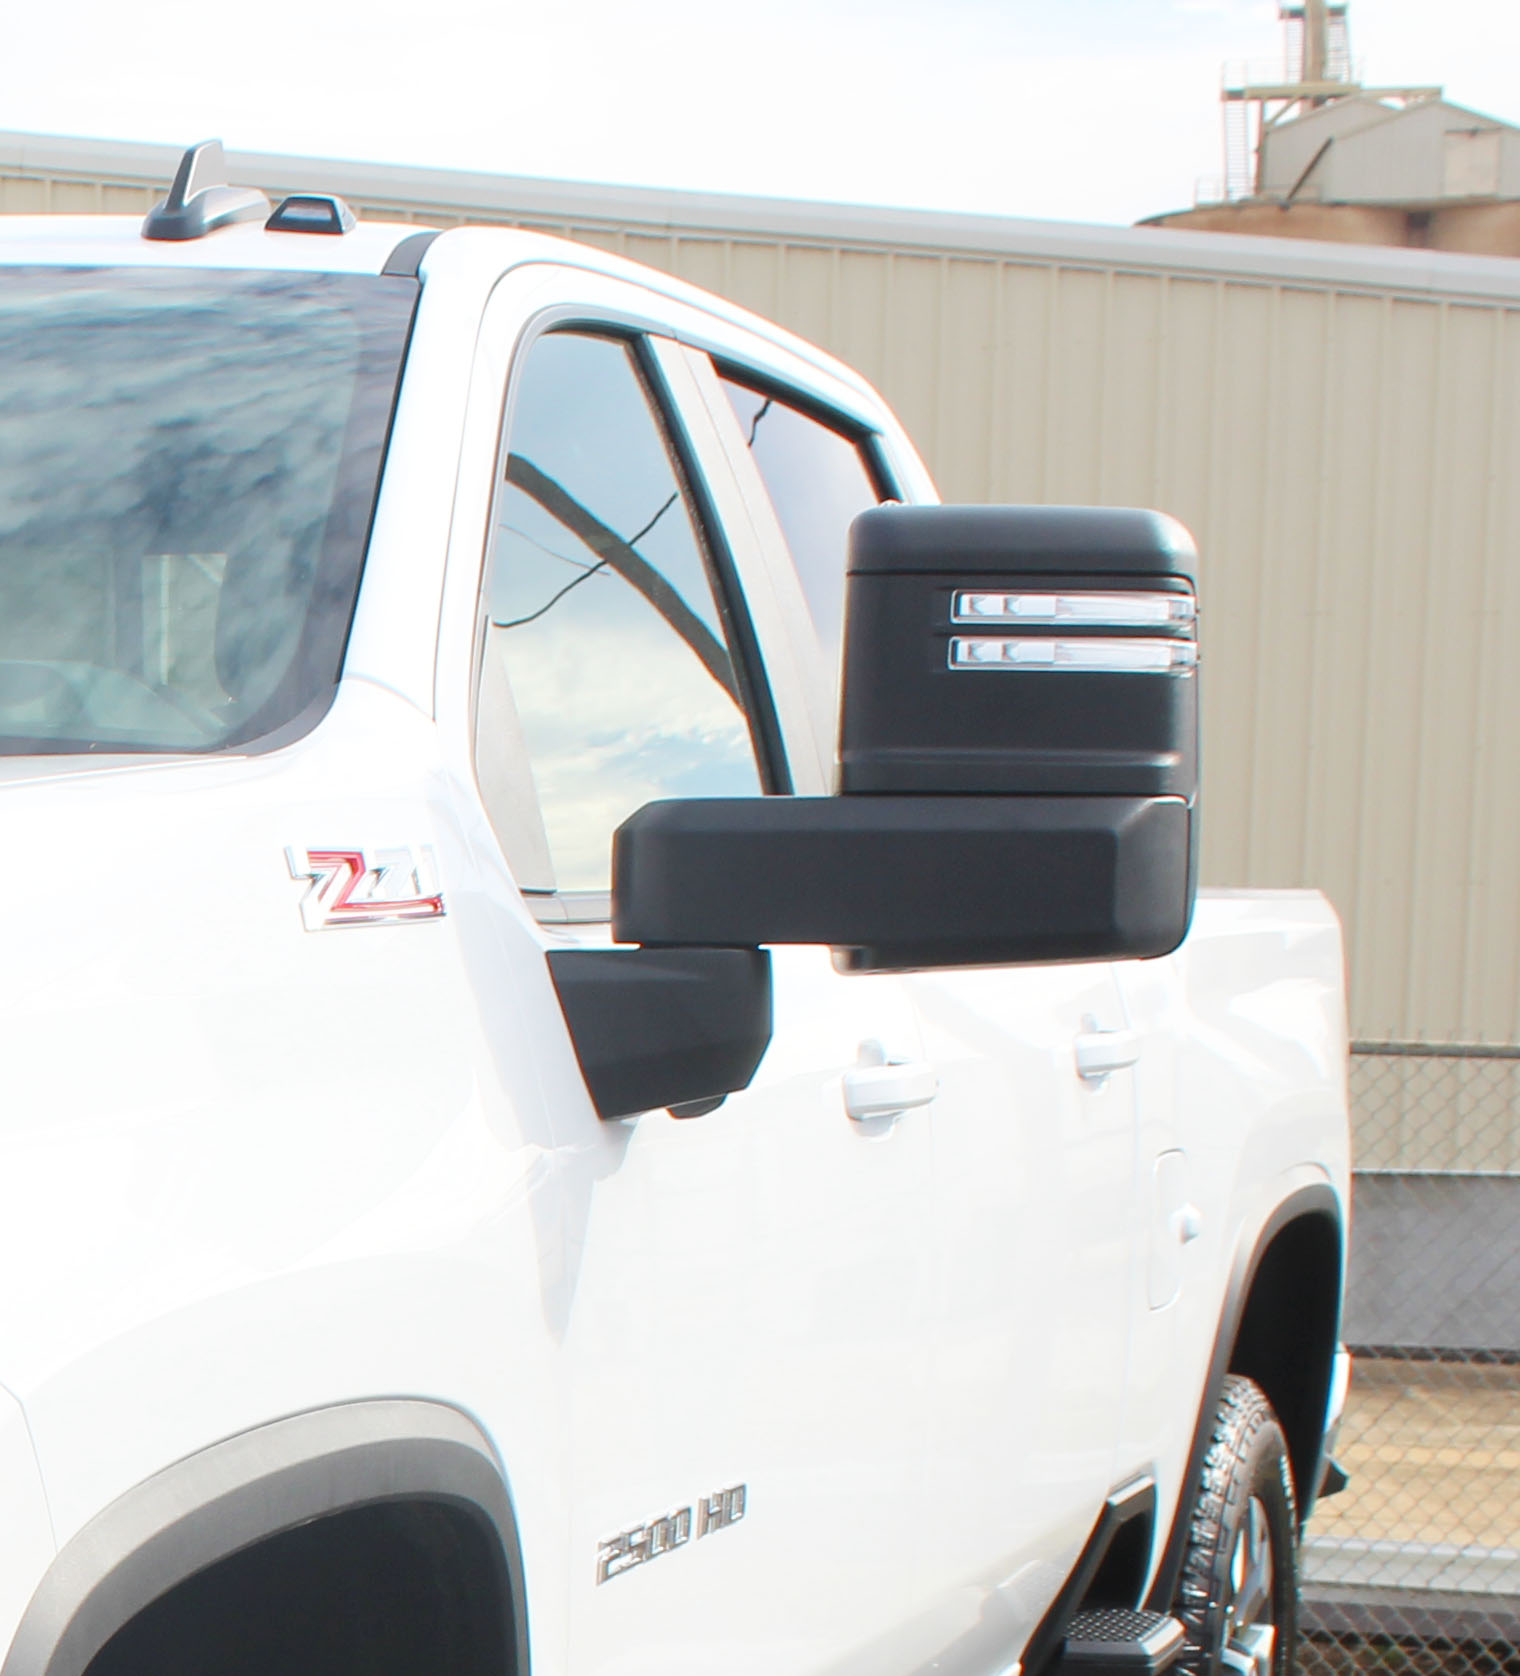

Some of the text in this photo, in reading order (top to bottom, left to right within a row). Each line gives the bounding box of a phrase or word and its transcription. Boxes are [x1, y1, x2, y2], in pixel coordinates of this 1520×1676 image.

[283, 846, 447, 932] Z71
[595, 1482, 748, 1586] 2500 HD
